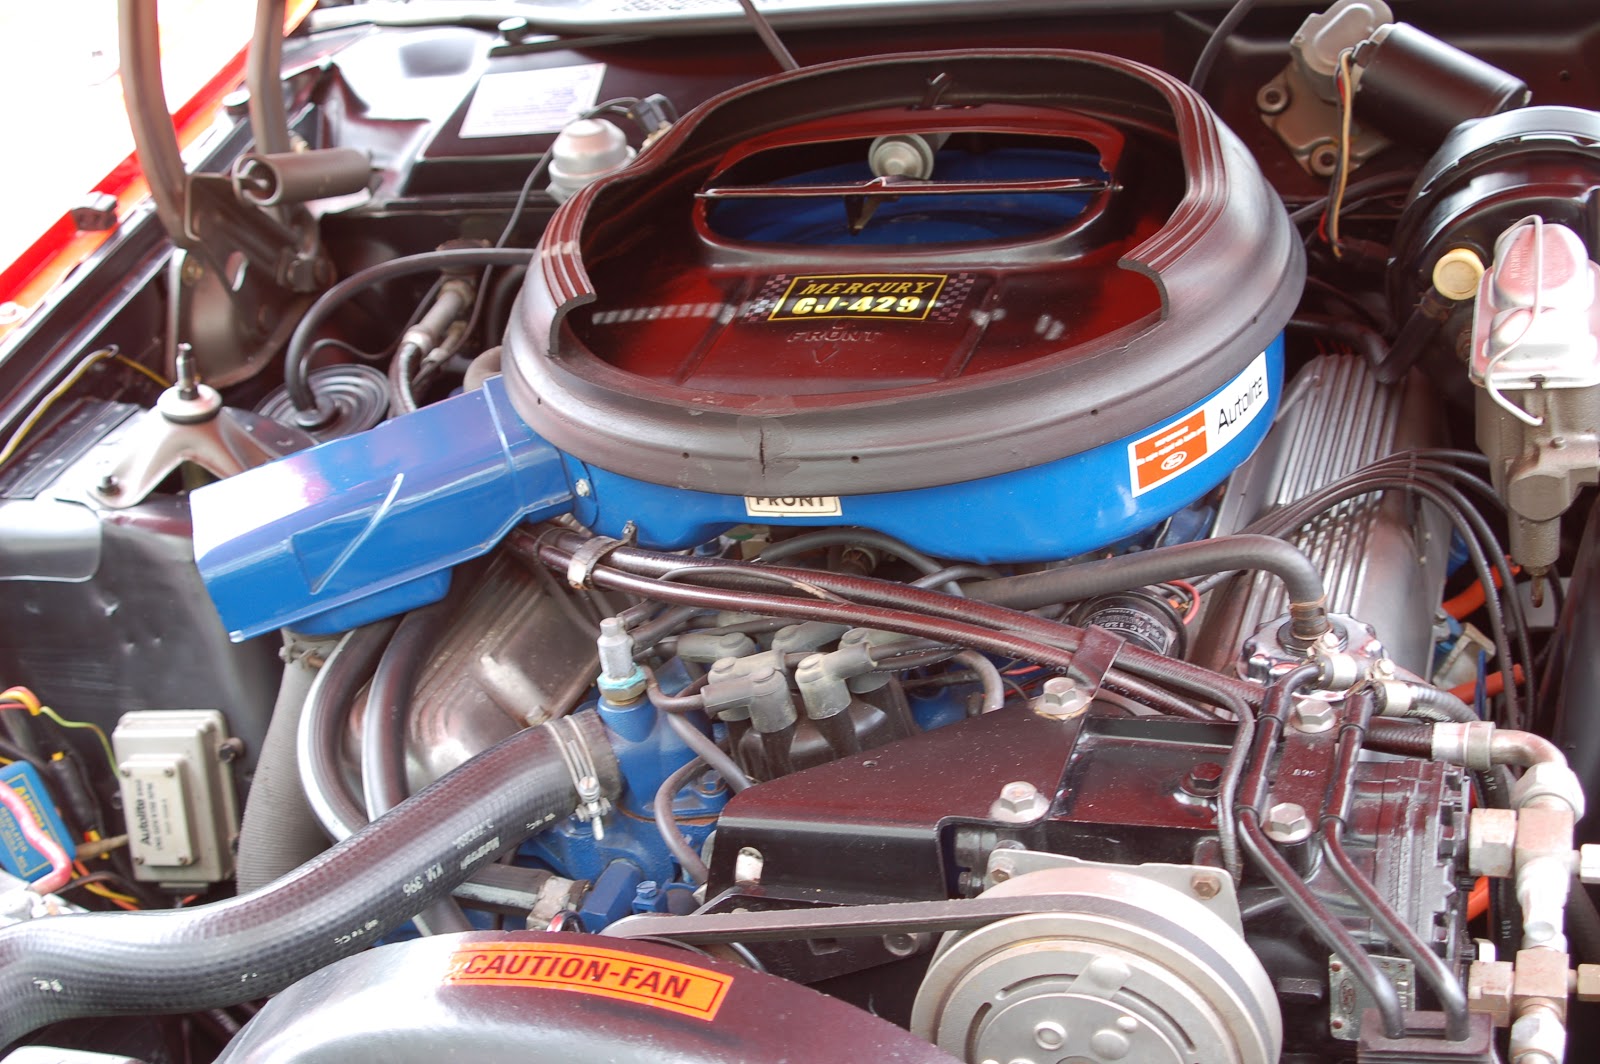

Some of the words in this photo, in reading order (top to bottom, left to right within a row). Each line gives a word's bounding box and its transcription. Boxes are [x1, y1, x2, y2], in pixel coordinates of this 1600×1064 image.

[798, 281, 935, 295] MERCURY
[787, 330, 884, 344] FRONT
[1217, 376, 1263, 435] Autolite
[135, 796, 151, 846] Autolite
[403, 876, 424, 897] 396
[464, 954, 692, 999] CAUTION-FAN
